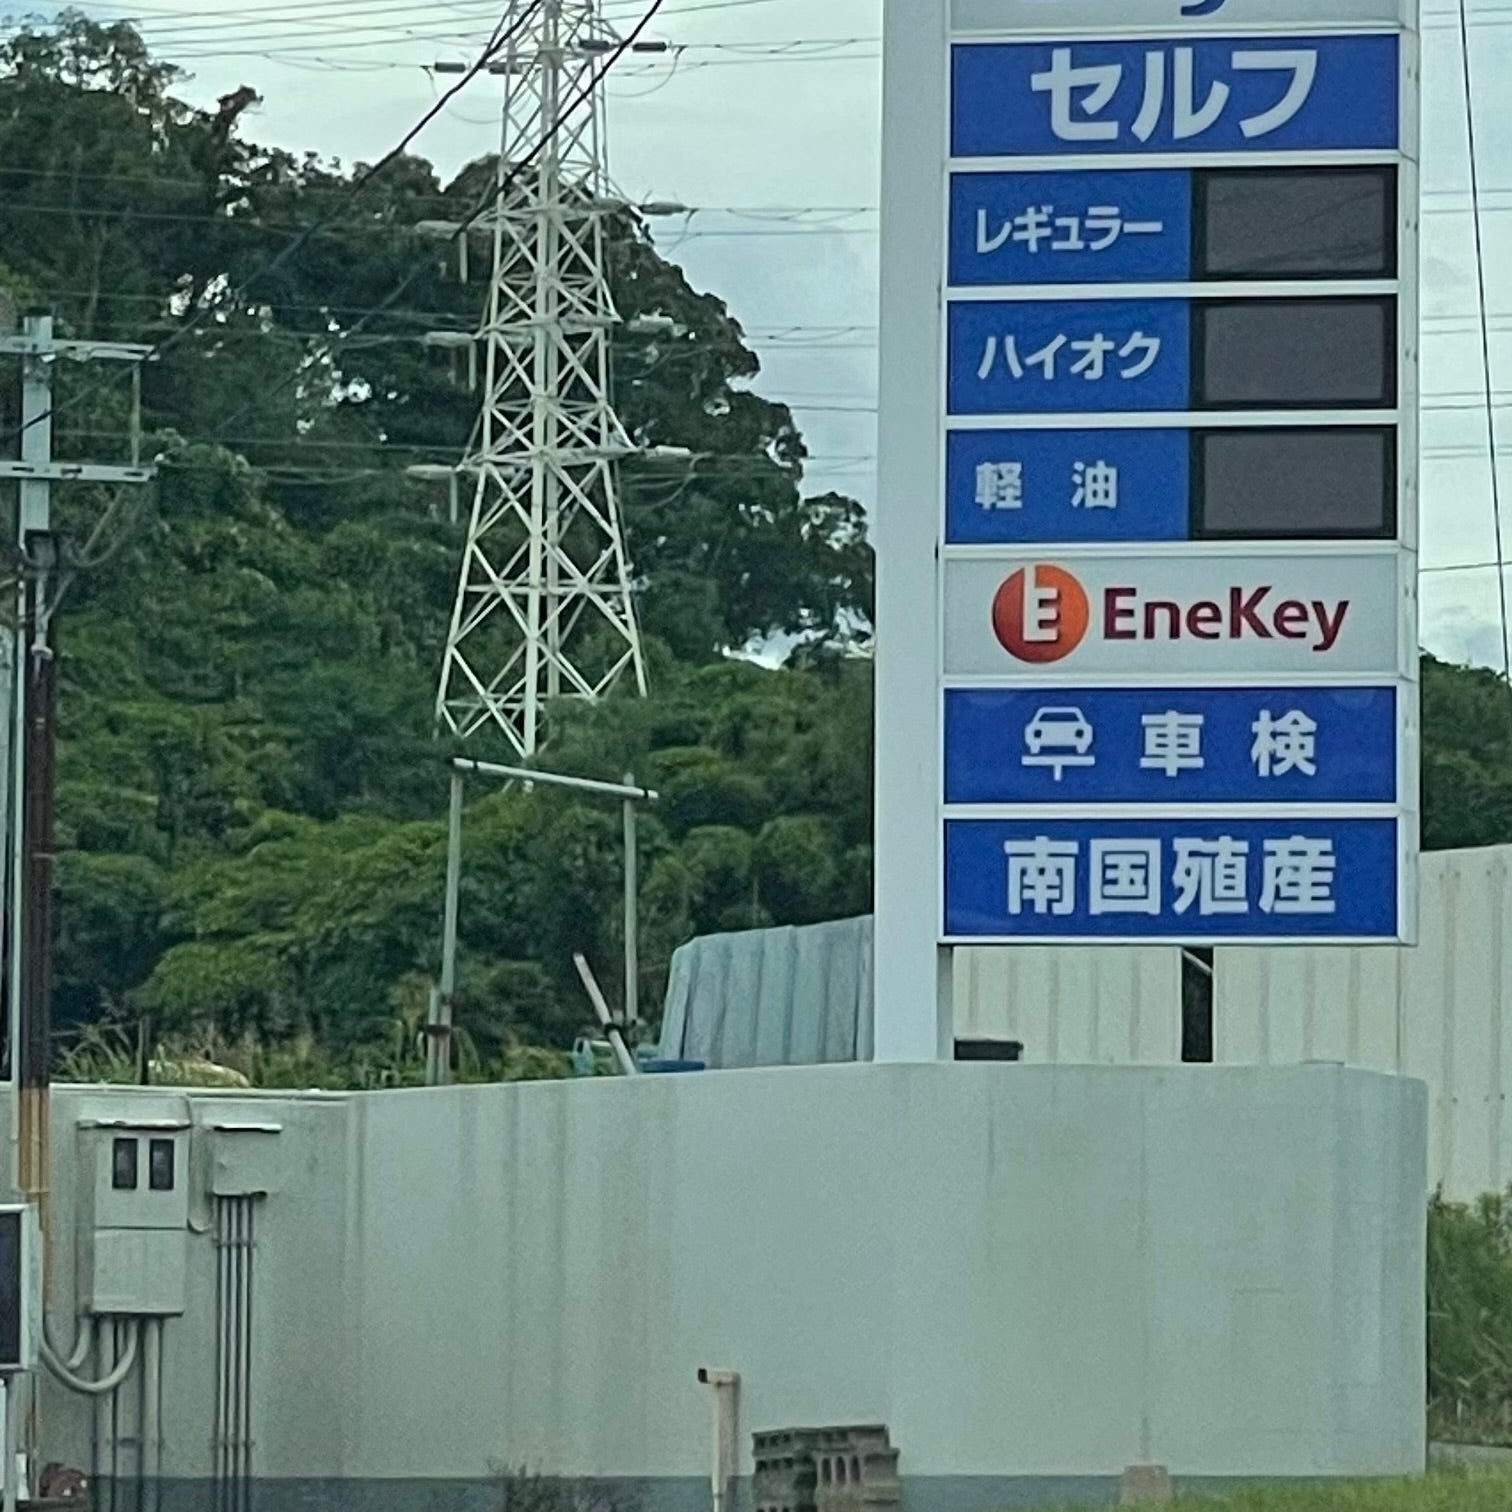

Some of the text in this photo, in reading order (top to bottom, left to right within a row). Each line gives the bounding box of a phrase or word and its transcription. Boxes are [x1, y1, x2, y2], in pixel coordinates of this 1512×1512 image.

[1030, 47, 1319, 143] セルフ
[976, 205, 1164, 254] レギュラー
[976, 331, 1161, 381] ハイオク
[974, 459, 1119, 510] 軽油
[1102, 585, 1350, 652] EneKey
[1139, 709, 1319, 778] 車検
[1003, 835, 1337, 916] 南国殖産
